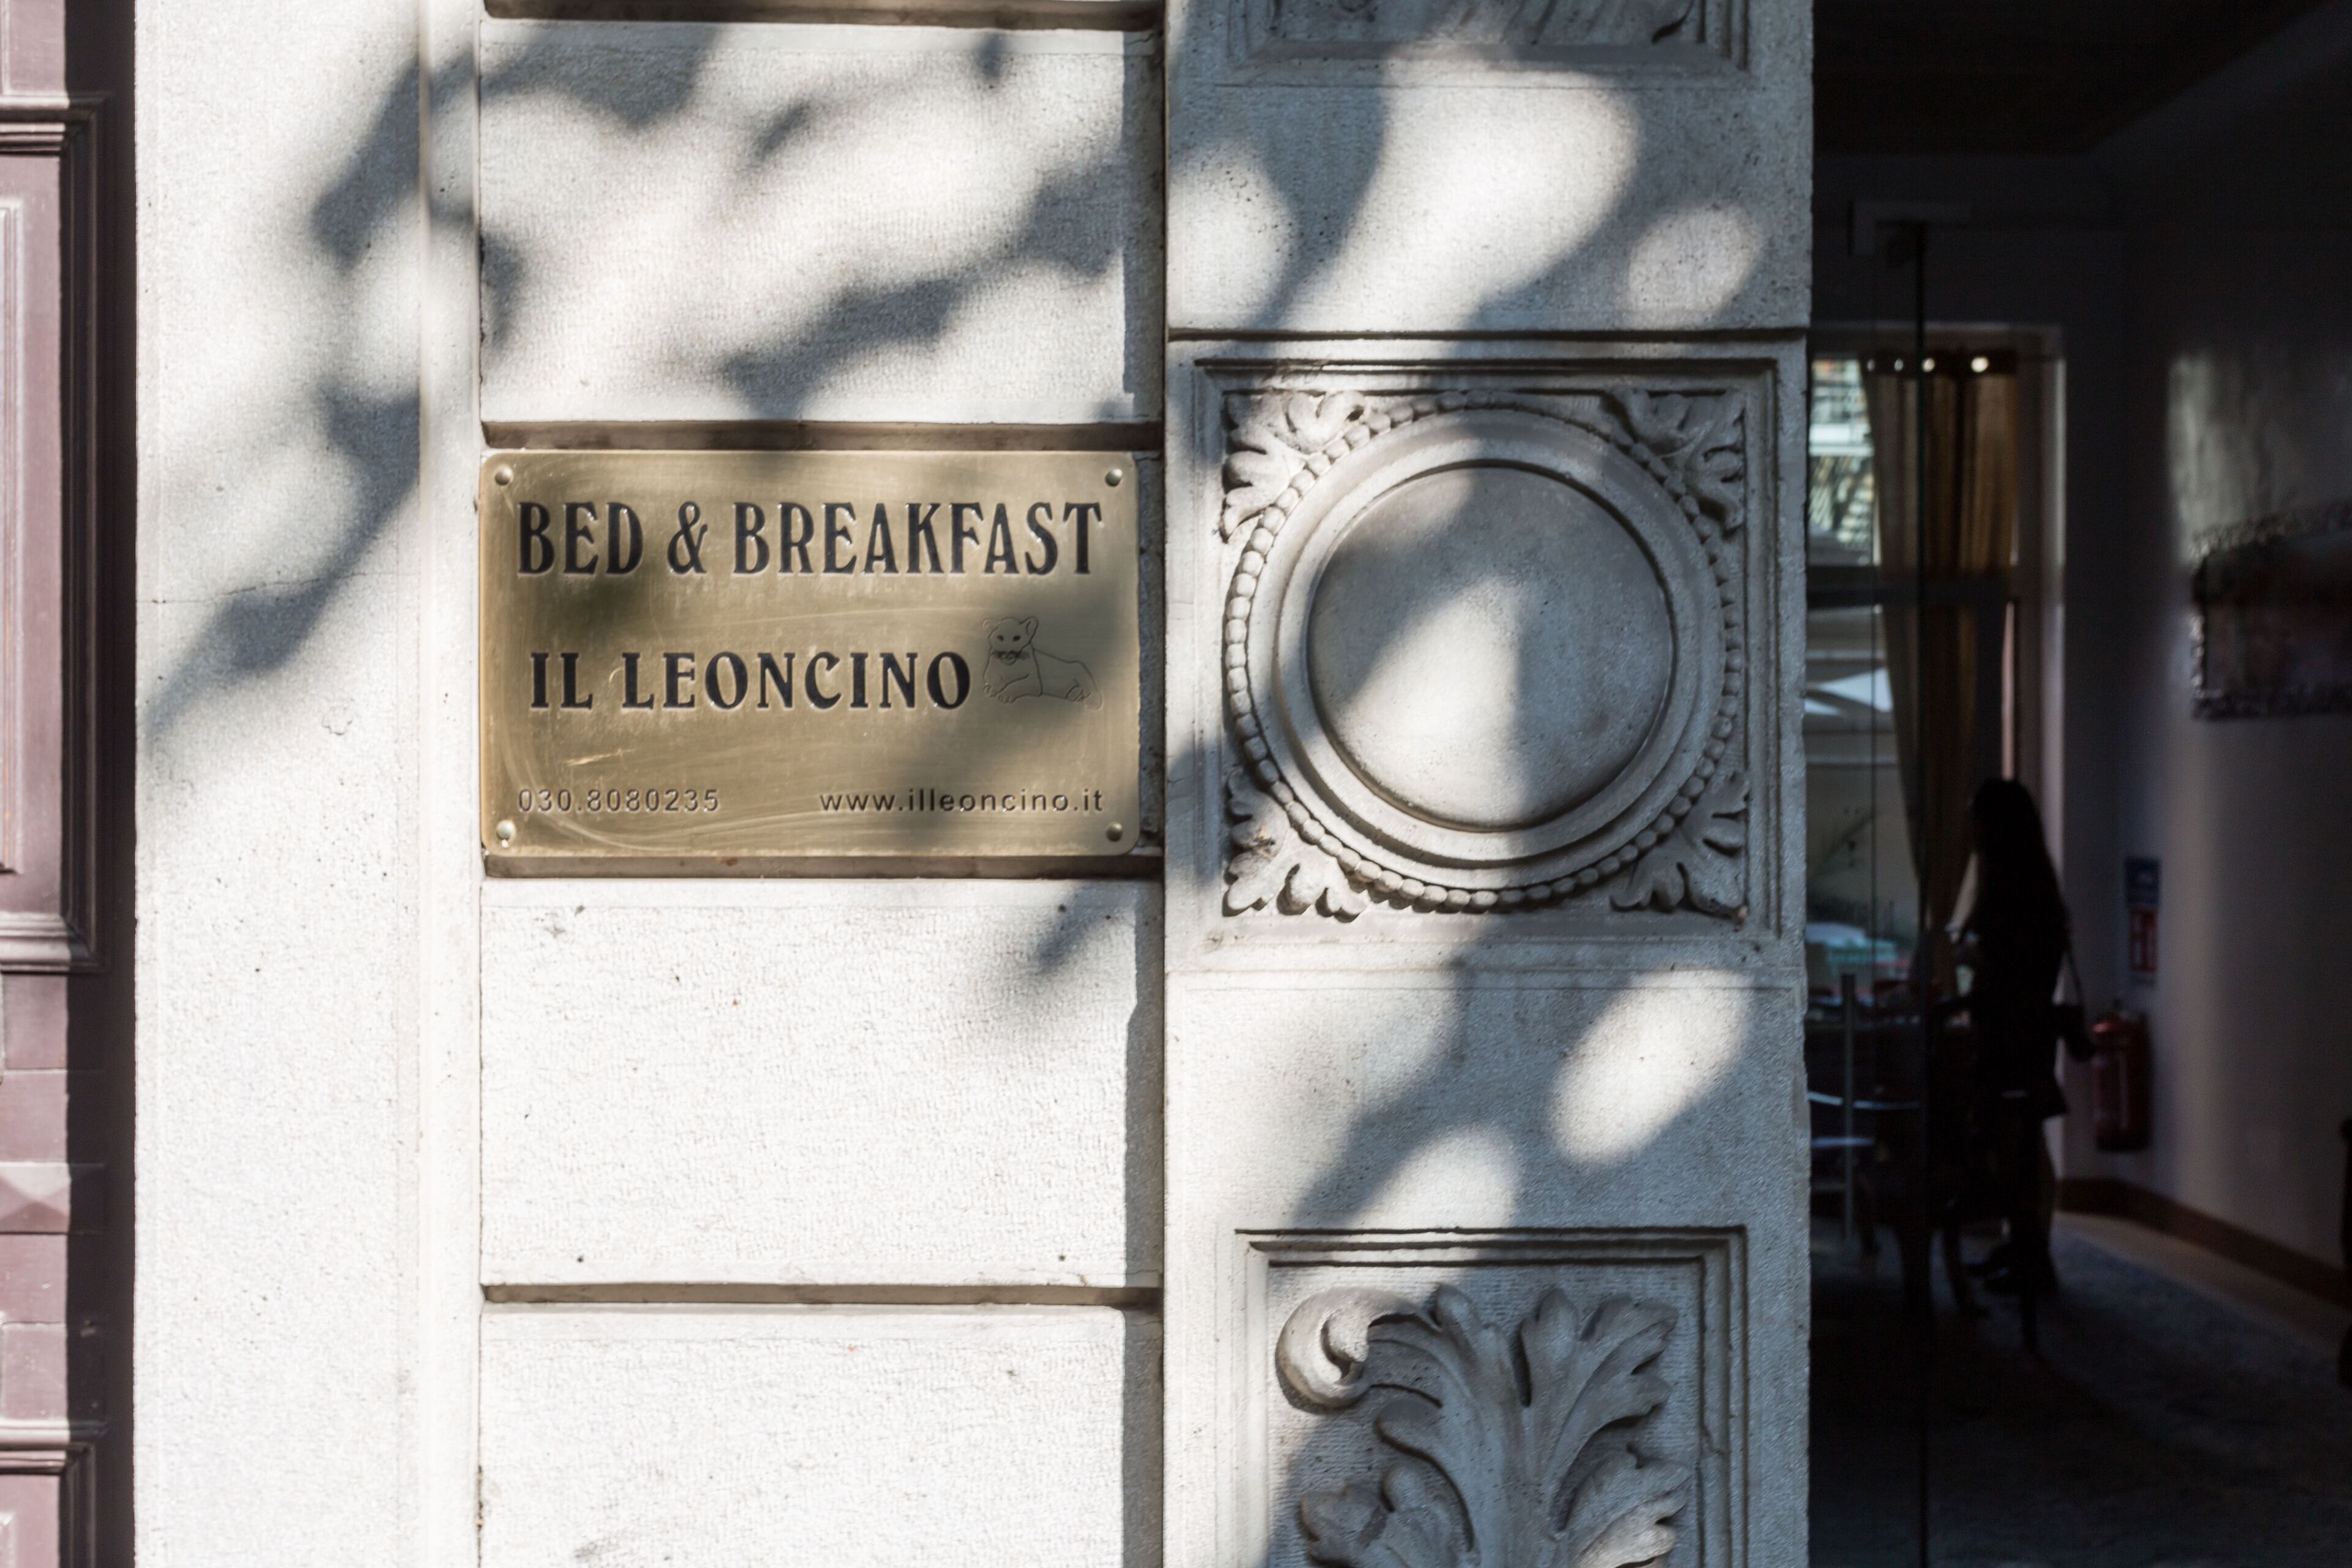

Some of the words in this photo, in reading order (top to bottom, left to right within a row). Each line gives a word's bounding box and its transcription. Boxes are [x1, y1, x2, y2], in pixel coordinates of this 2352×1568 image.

[518, 502, 643, 575] BED
[667, 502, 708, 575] &
[733, 502, 1102, 575] BREAKFAST
[530, 652, 592, 709] IL
[621, 652, 970, 709] LEONCINO
[518, 789, 720, 812] 030.8080235
[820, 789, 1103, 813] www.illeoncino.it
